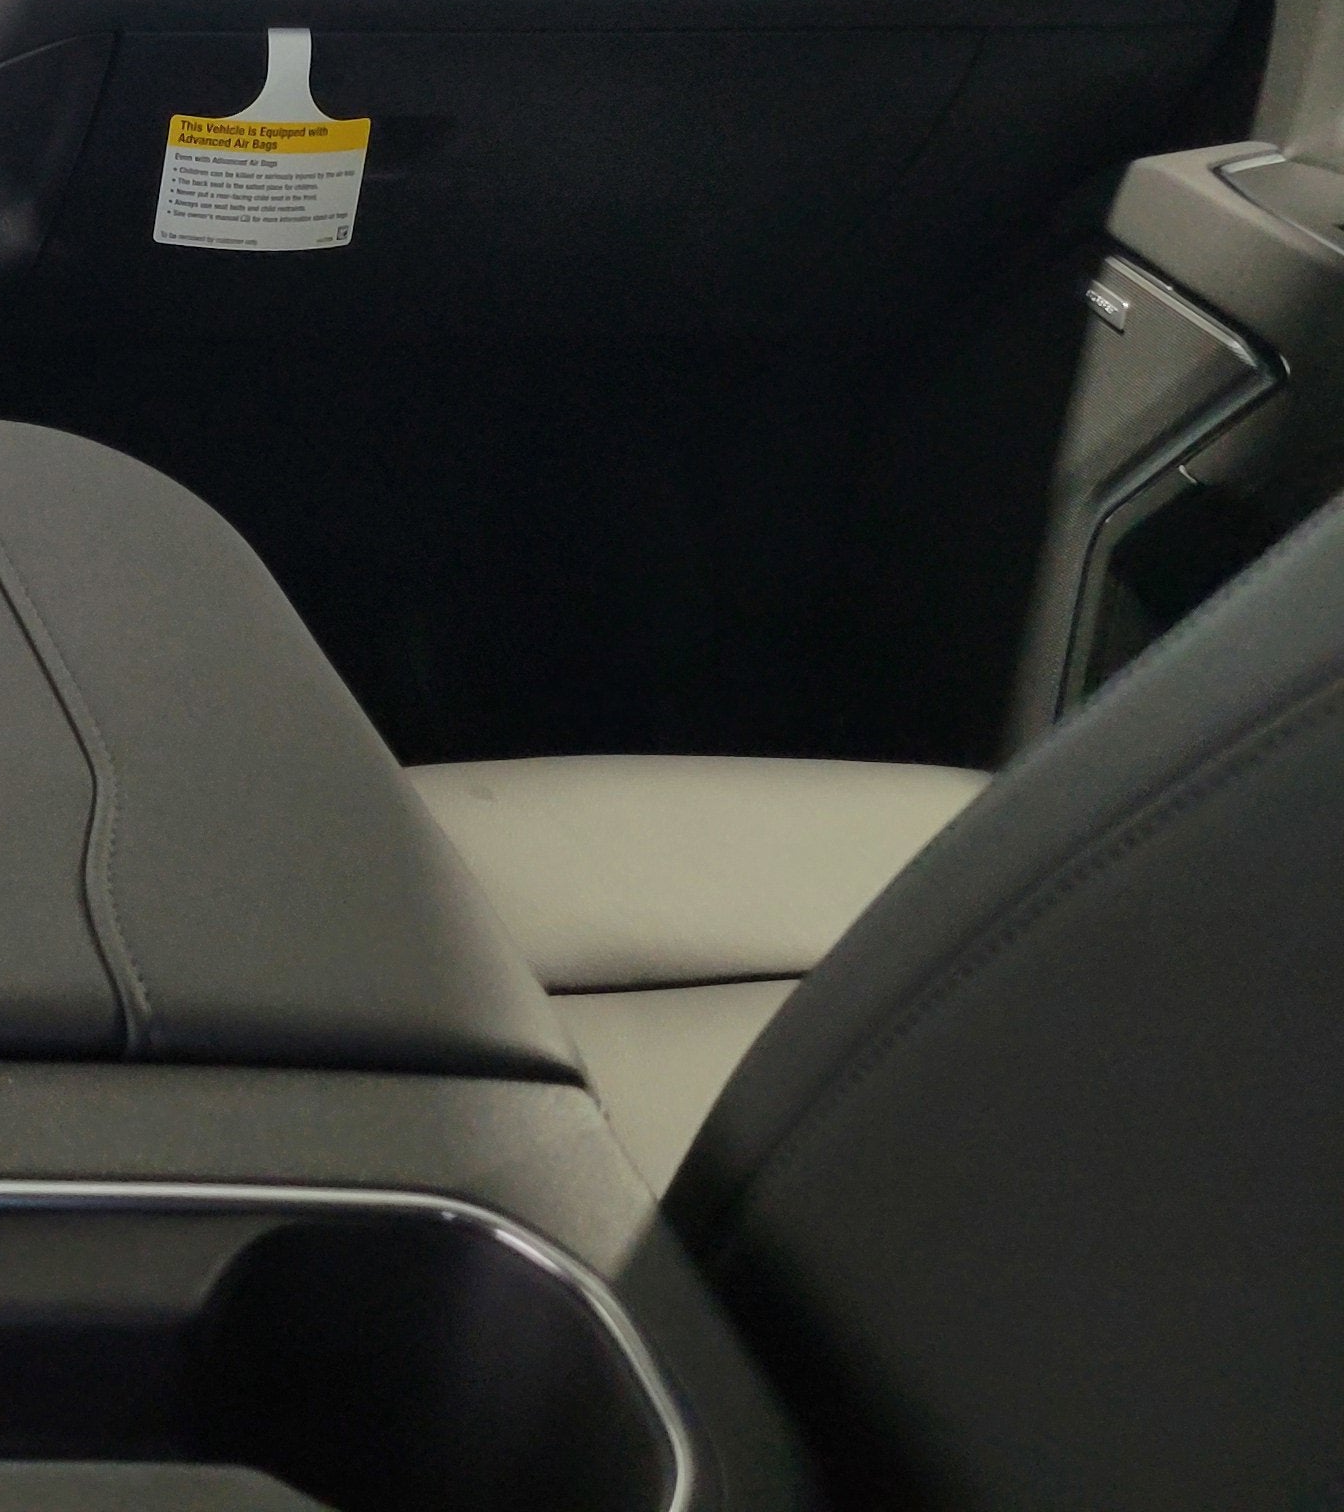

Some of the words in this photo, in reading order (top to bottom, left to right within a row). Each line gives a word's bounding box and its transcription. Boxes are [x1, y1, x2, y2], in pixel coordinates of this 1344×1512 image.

[181, 120, 203, 133] This
[206, 123, 245, 136] Vehicle
[248, 126, 257, 136] is
[260, 126, 306, 139] Equipped
[308, 127, 329, 137] with
[178, 133, 231, 148] Advanced
[233, 138, 249, 149] Air
[252, 139, 278, 152] Bags
